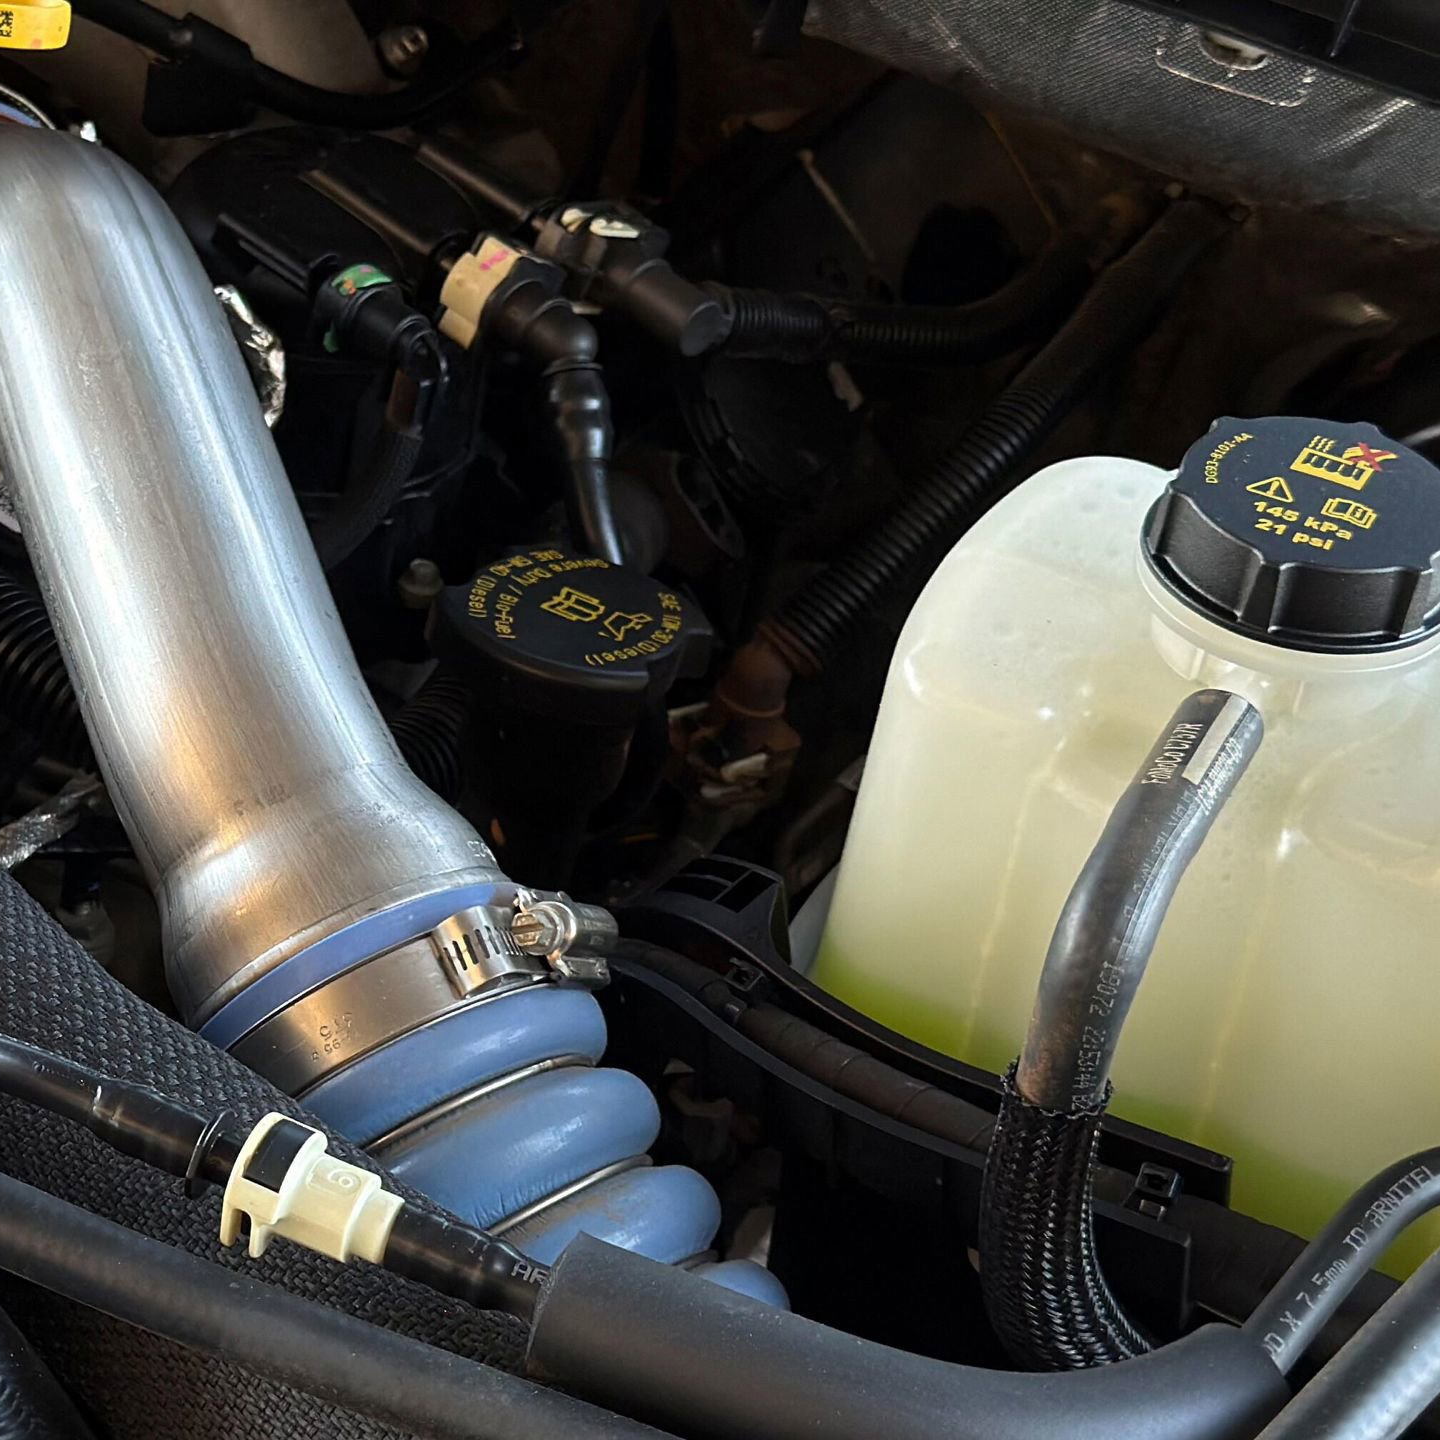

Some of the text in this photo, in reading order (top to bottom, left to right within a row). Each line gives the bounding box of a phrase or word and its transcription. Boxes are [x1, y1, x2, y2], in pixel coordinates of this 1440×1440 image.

[1253, 501, 1352, 540] 145 kPa
[1254, 518, 1333, 550] 21 psi
